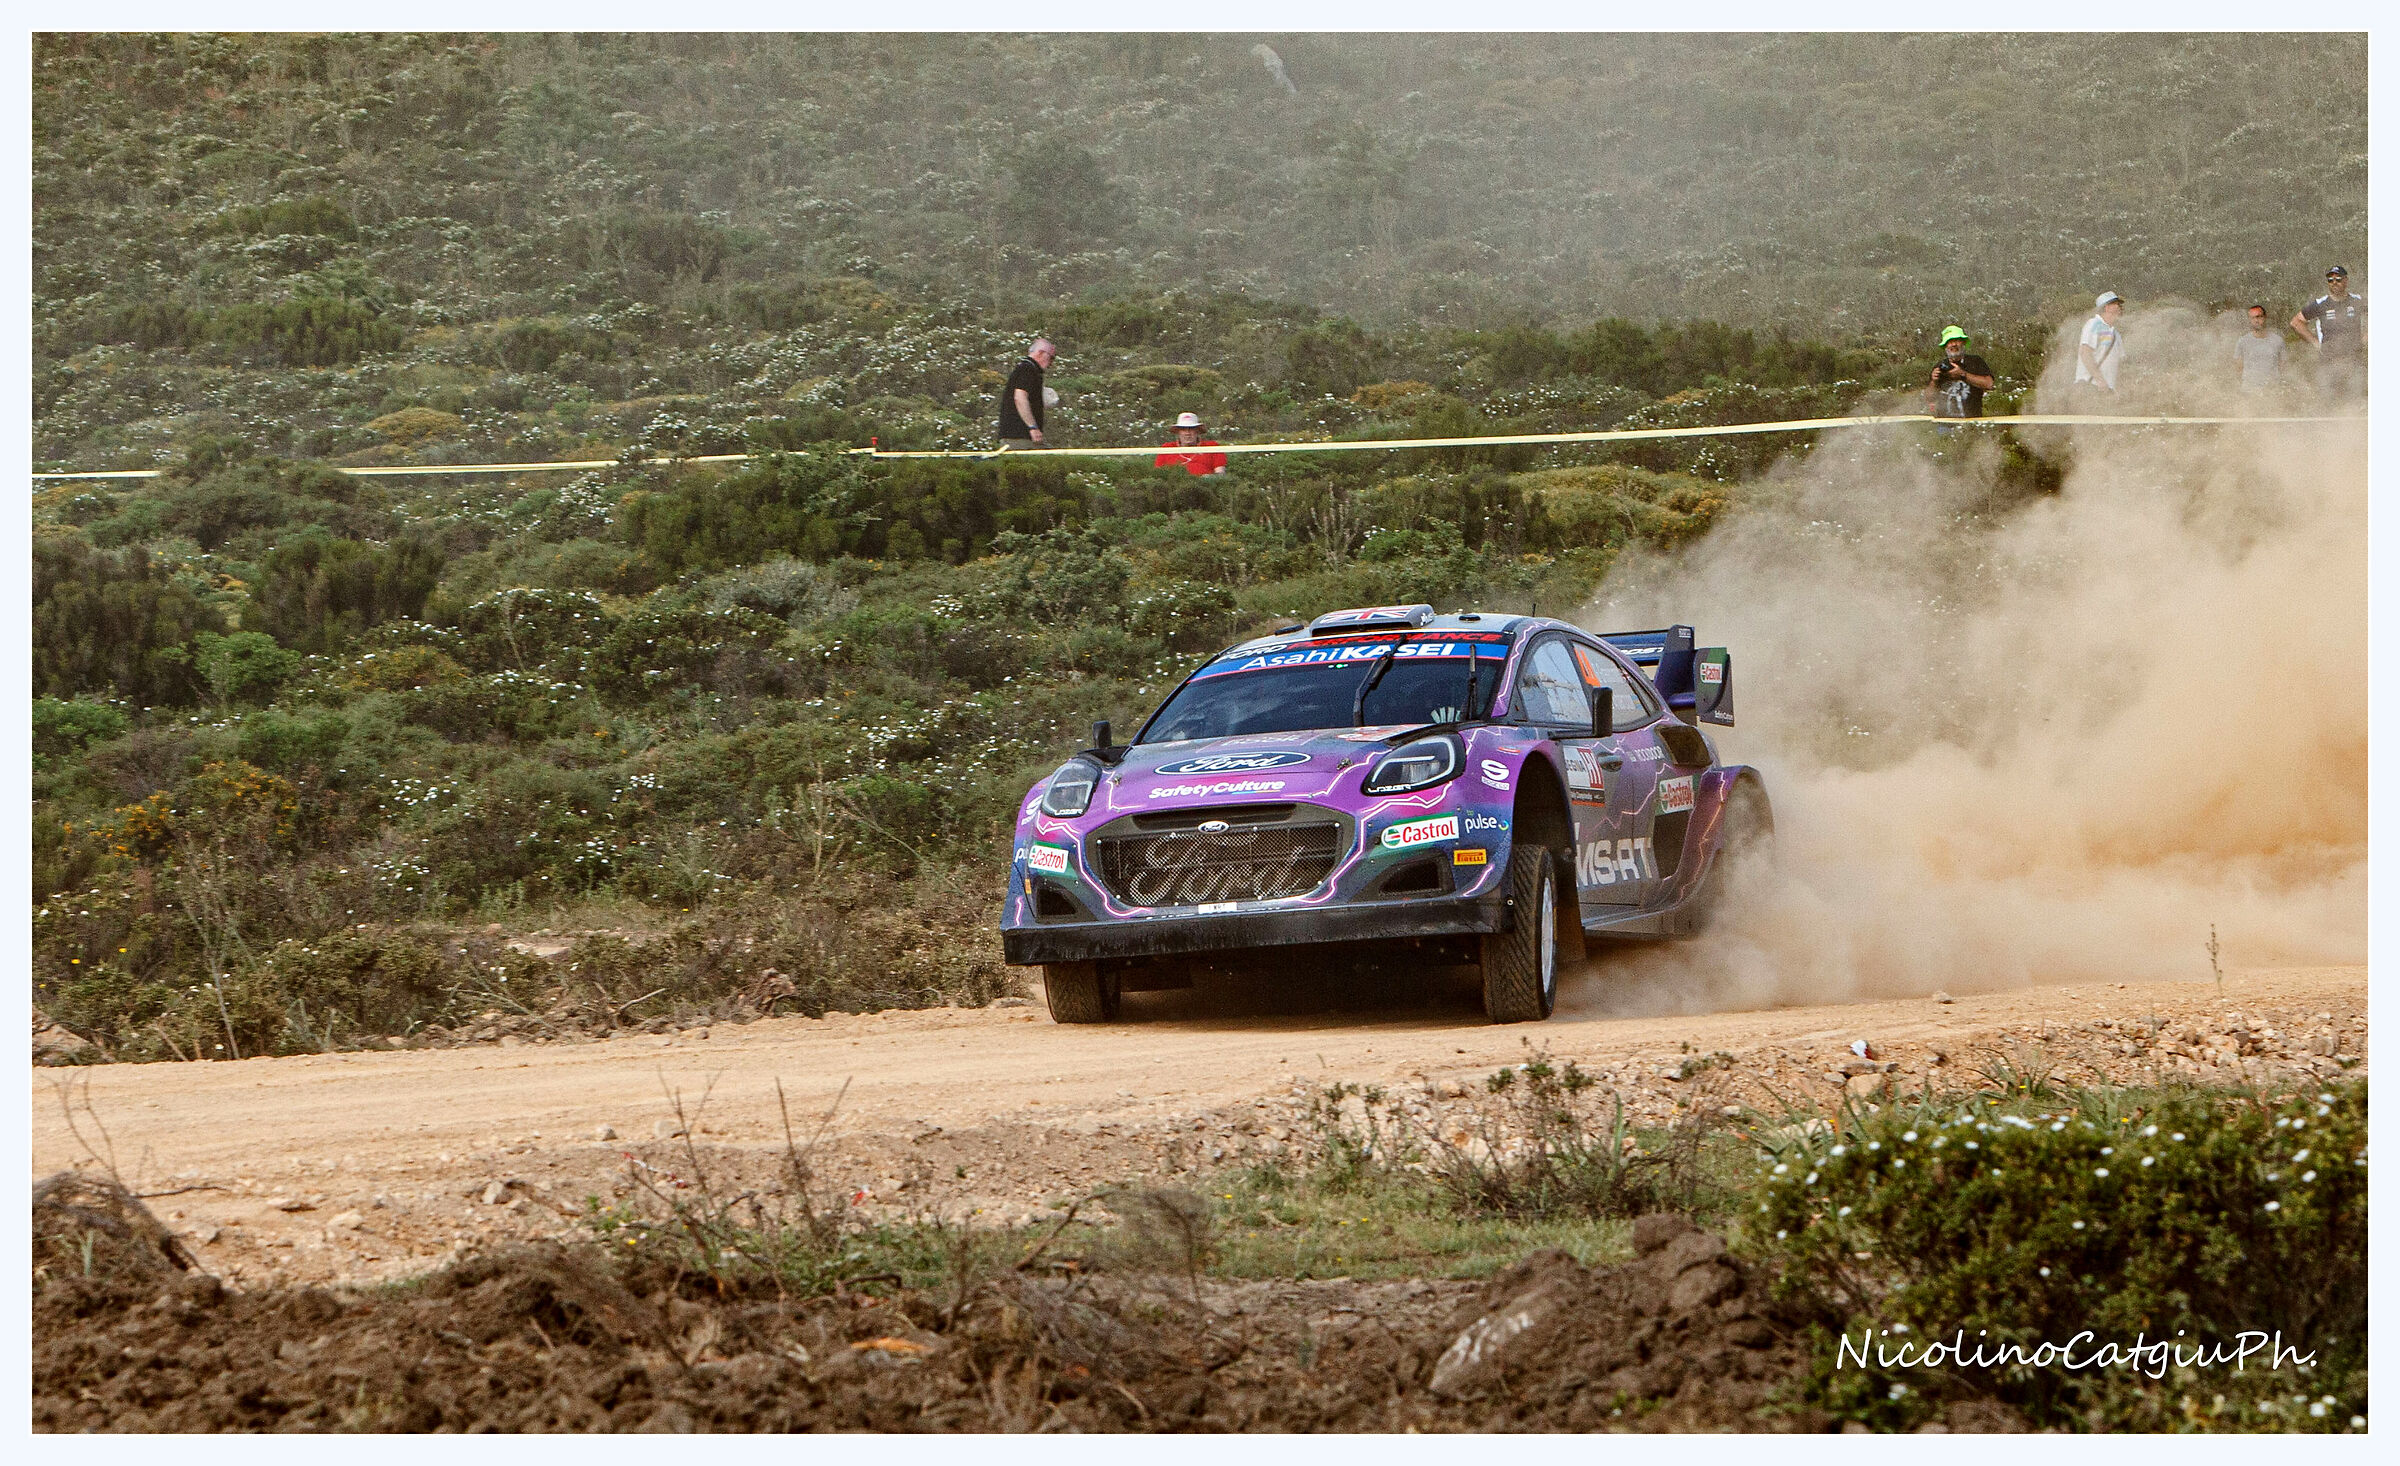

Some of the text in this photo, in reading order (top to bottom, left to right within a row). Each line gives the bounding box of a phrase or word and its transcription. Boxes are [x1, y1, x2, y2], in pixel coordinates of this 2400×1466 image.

[1179, 754, 1286, 773] Ford
[1149, 780, 1286, 799] SafetyCulture
[1402, 820, 1456, 843] Castrol
[1464, 813, 1498, 834] pulse
[1034, 849, 1065, 870] Castrol
[1457, 852, 1484, 862] PIRELLI
[1130, 834, 1304, 906] Ford
